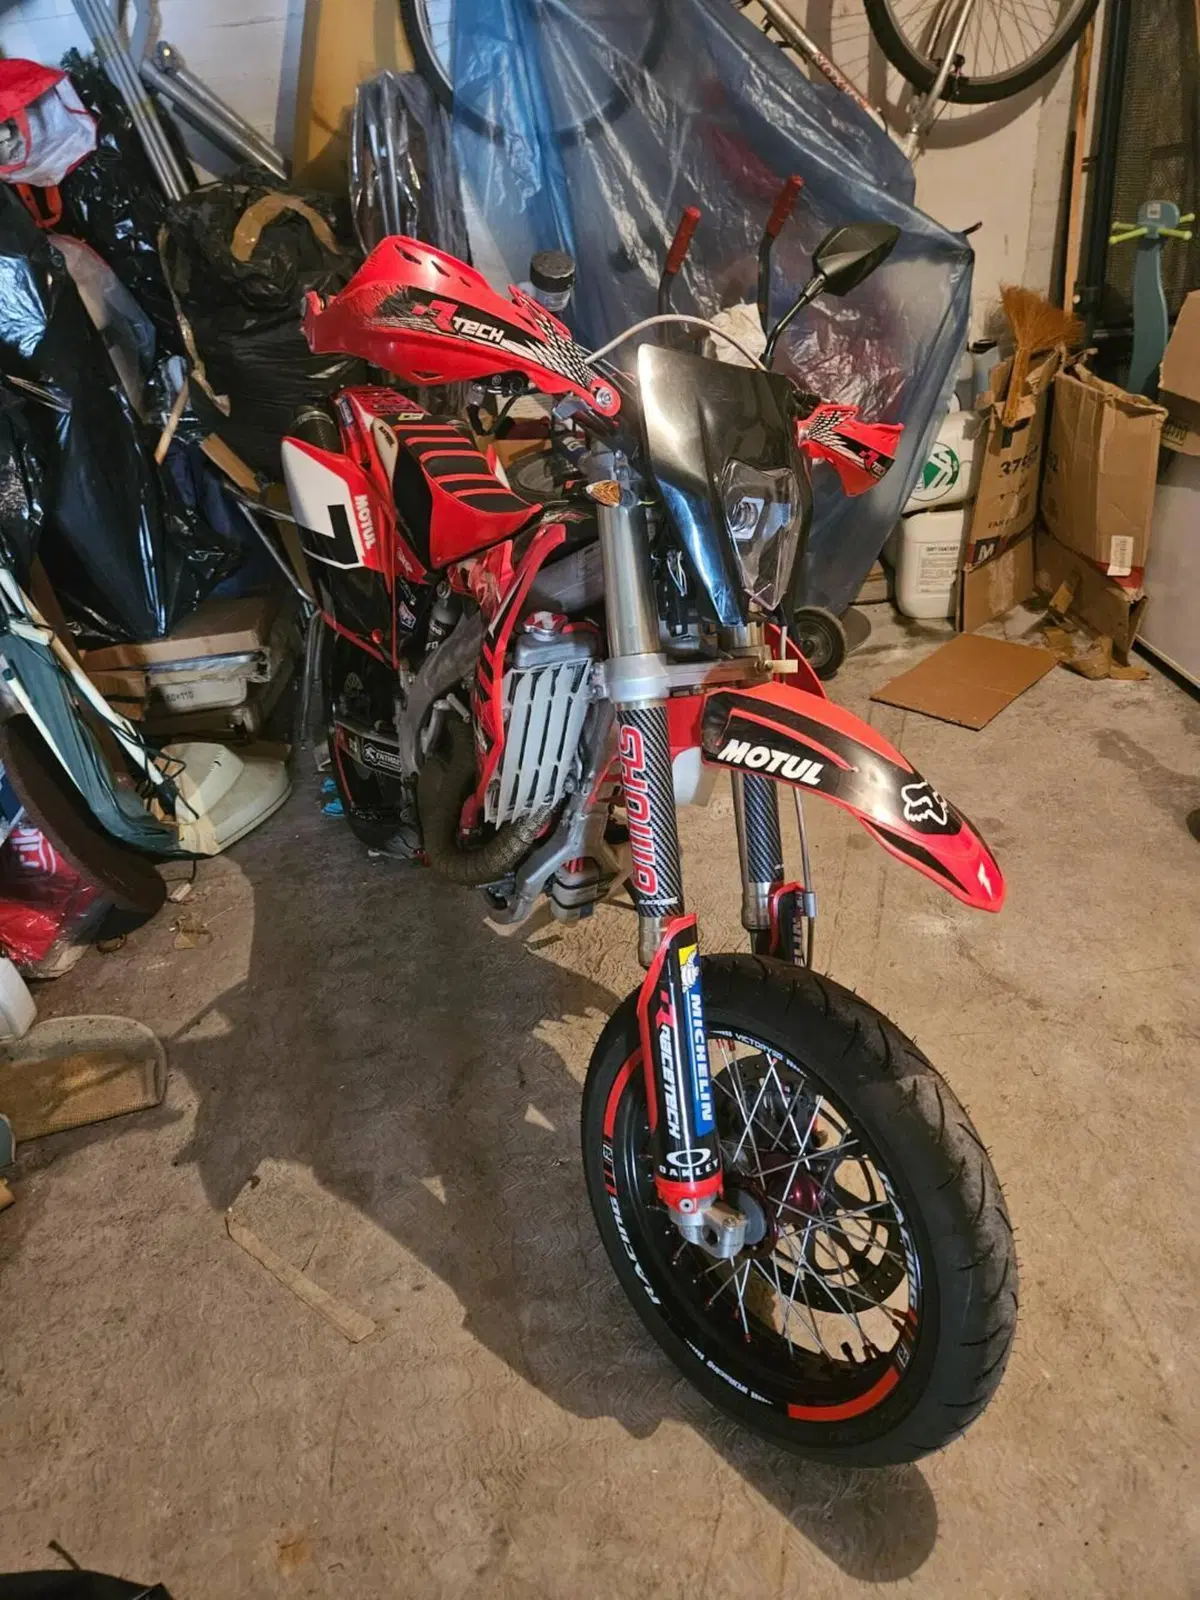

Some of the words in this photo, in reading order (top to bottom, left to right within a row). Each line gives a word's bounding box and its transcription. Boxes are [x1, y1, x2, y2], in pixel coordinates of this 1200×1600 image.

[354, 494, 376, 550] MOTUL
[717, 738, 825, 785] MOTUL
[660, 1024, 681, 1140] RACETECH
[690, 993, 713, 1121] MICHELIN
[659, 1158, 719, 1178] OAKLEY
[610, 1196, 662, 1305] RACING
